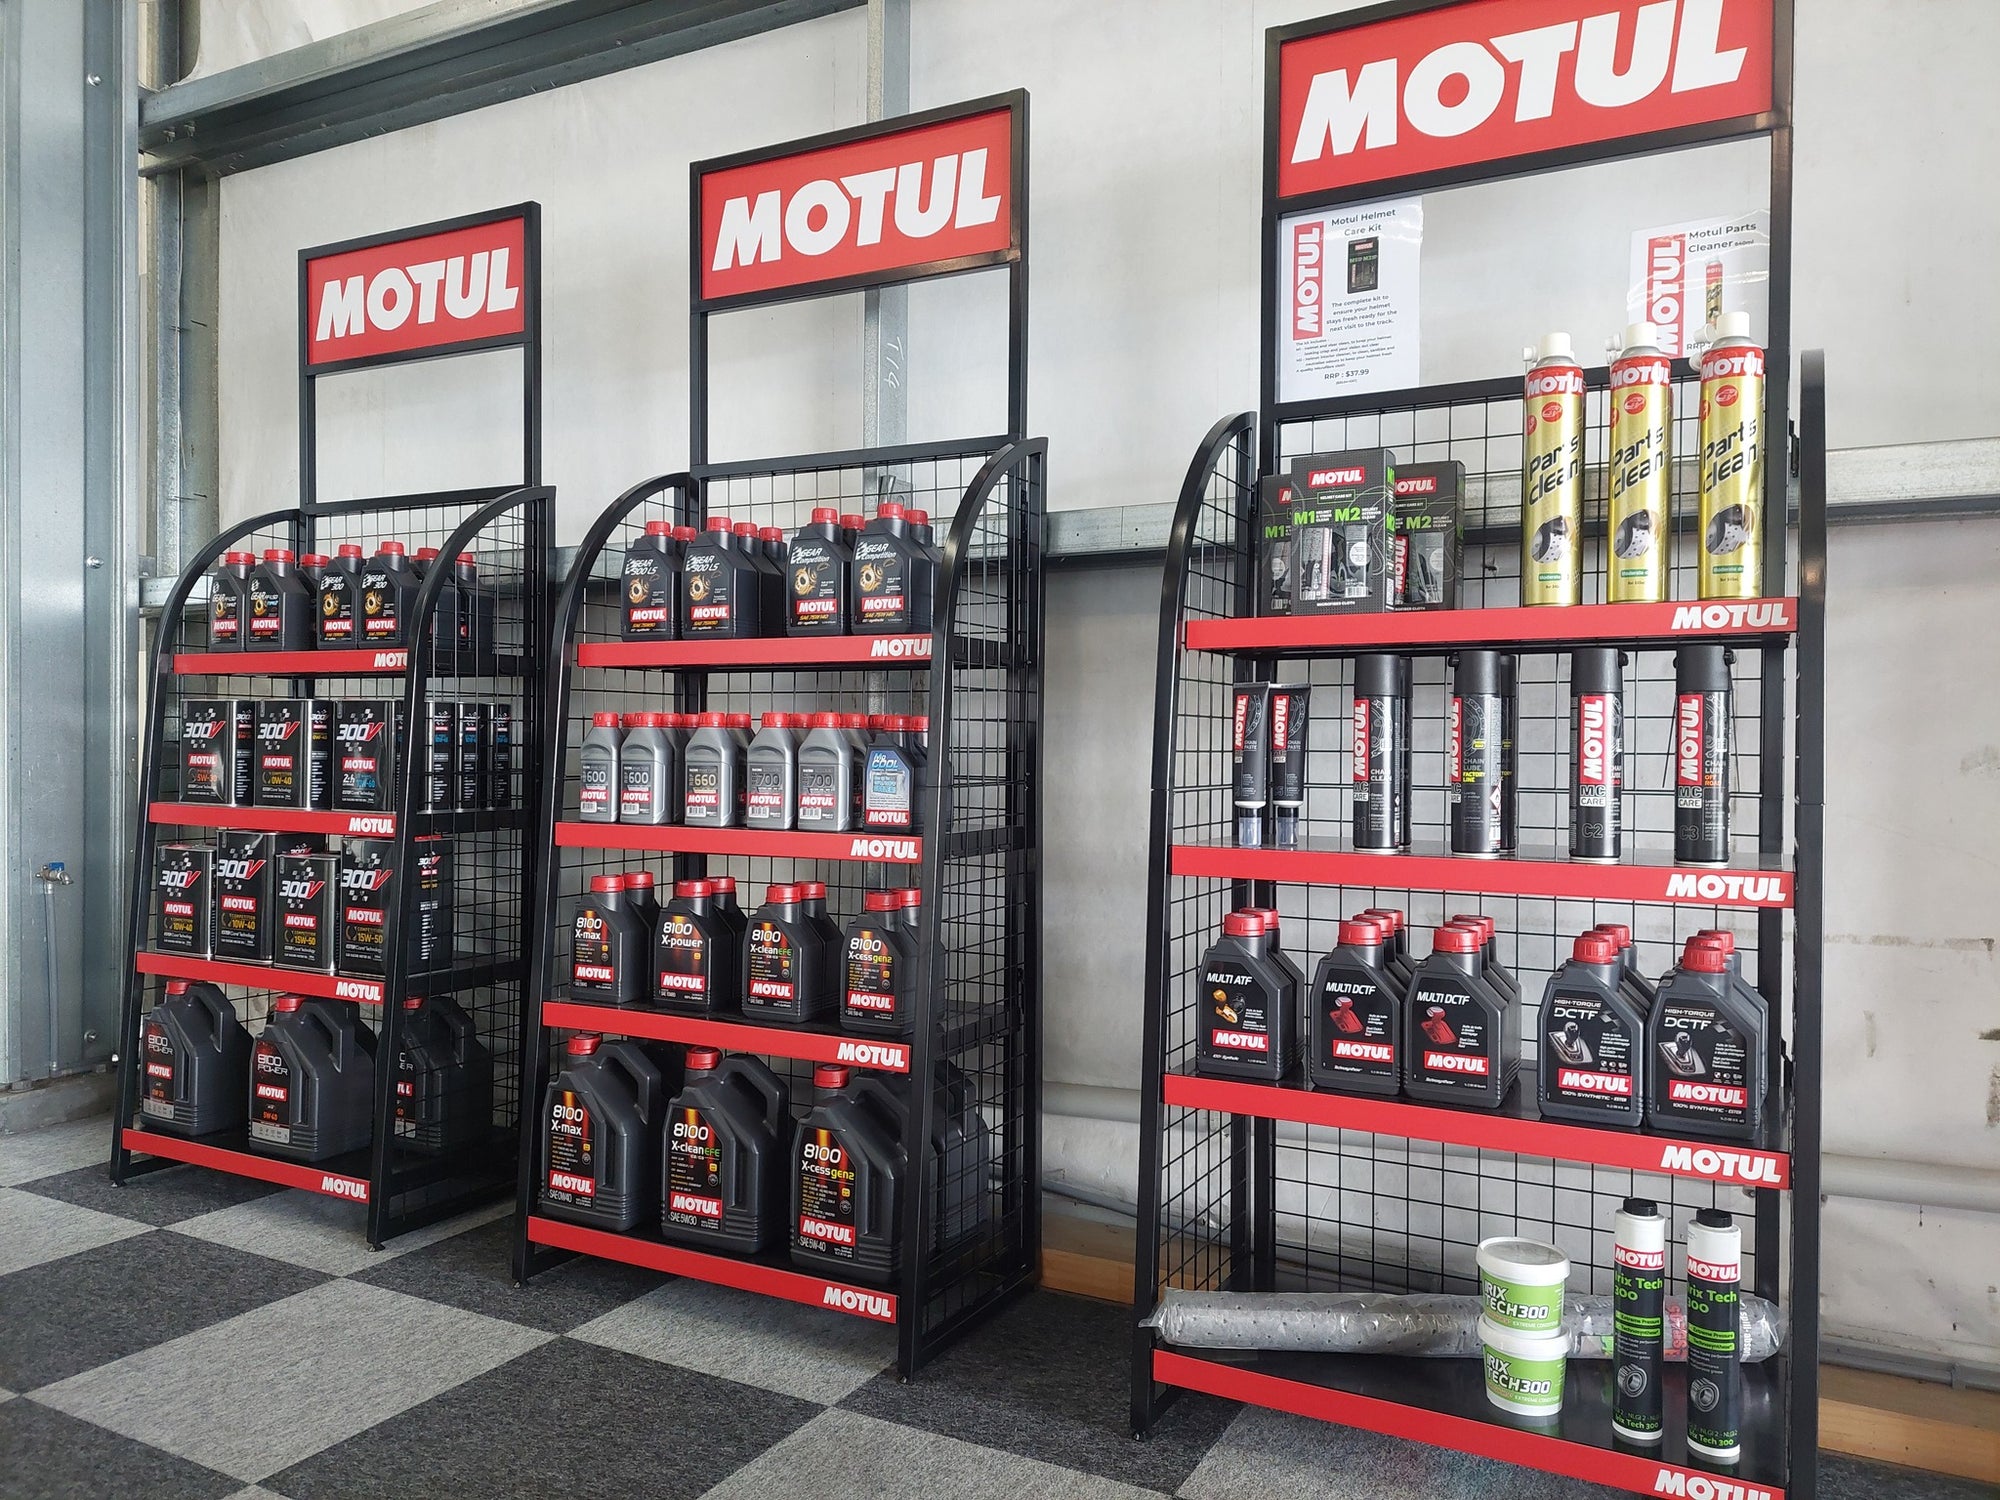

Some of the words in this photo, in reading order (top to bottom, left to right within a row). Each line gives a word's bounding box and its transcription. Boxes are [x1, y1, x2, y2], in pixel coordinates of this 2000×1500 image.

[1291, 0, 1748, 164] MOTUL
[711, 147, 1002, 271] MOTUL
[1331, 215, 1359, 226] Motul
[1361, 209, 1396, 221] Helmet
[1344, 227, 1366, 237] Care
[1368, 224, 1382, 233] Kit
[1689, 227, 1722, 240] Motul
[1726, 223, 1757, 234] Parts
[1688, 240, 1733, 253] Cleaner
[1297, 227, 1320, 333] MOTUL
[315, 247, 519, 342] MOTUL
[1651, 240, 1681, 355] MOTUL
[1333, 308, 1353, 316] ensure
[1354, 306, 1368, 314] your
[1369, 302, 1391, 310] helmet
[1344, 298, 1371, 307] complete
[1326, 318, 1341, 326] stays
[1359, 312, 1376, 321] ready
[1325, 372, 1340, 380] RRP
[1345, 368, 1370, 378] $37.99
[1611, 362, 1670, 388] MOTUL
[1701, 355, 1763, 381] MOTUL
[1527, 375, 1584, 396] MOTUL
[1311, 469, 1362, 486] MOTUL
[1294, 510, 1315, 525] M1
[1334, 507, 1361, 522] M2
[1406, 516, 1432, 529] M2
[1265, 525, 1285, 538] M1
[801, 547, 823, 557] GEAR
[866, 543, 889, 552] GEAR
[796, 556, 830, 565] Competition
[861, 552, 897, 561] Competition
[799, 601, 835, 613] MOTUL
[864, 598, 902, 610] MOTUL
[632, 609, 665, 620] MOTUL
[693, 607, 728, 618] MOTUL
[1671, 604, 1788, 630] MOTUL
[214, 621, 236, 630] MOTUL
[252, 620, 278, 629] MOTUL
[325, 621, 351, 631] MOTUL
[367, 620, 394, 630] MOTUL
[1235, 698, 1246, 747] MOTUL
[1274, 698, 1287, 747] MOTUL
[183, 721, 226, 739] 300V
[257, 721, 300, 740] 300V
[336, 722, 385, 741] 300V
[1354, 703, 1366, 777] MOTUL
[1451, 702, 1459, 777] MOTUL
[1584, 700, 1605, 780] MOTUL
[1681, 698, 1699, 782] MOTUL
[189, 755, 217, 764] MOTUL
[264, 757, 291, 767] MOTUL
[344, 759, 374, 770] MOTUL
[872, 760, 899, 769] COOL
[271, 776, 292, 785] 0W-40
[587, 771, 606, 783] 600
[629, 772, 649, 784] 600
[694, 774, 716, 786] 660
[759, 773, 781, 786] 700
[810, 774, 834, 787] 700
[581, 791, 607, 800] MOTUL
[623, 792, 649, 802] MOTUL
[1580, 785, 1606, 797] MC
[1678, 786, 1702, 798] MC
[687, 794, 717, 804] MOTUL
[750, 795, 781, 805] MOTUL
[801, 796, 834, 806] MOTUL
[1581, 797, 1604, 806] CARE
[1679, 799, 1700, 807] CARE
[868, 811, 908, 824] MOTUL
[349, 817, 394, 833] MOTUL
[1582, 823, 1604, 839] C2
[1679, 825, 1700, 841] C3
[850, 839, 918, 859] MOTUL
[217, 858, 267, 880] 300V
[159, 870, 201, 888] 300V
[340, 868, 393, 891] 300V
[279, 880, 325, 900] 300V
[1666, 874, 1786, 901] MOTUL
[165, 904, 192, 914] MOTUL
[223, 897, 254, 910] MOTUL
[286, 915, 315, 927] MOTUL
[347, 909, 382, 923] MOTUL
[576, 917, 602, 929] 8100
[231, 919, 256, 930] 10W-40
[663, 921, 693, 935] 8100
[294, 935, 316, 946] 15W-50
[357, 932, 383, 944] 15W-50
[575, 928, 601, 940] X-max
[661, 934, 703, 948] X-power
[751, 929, 781, 943] 8100
[850, 938, 882, 952] 8100
[577, 967, 611, 980] MOTUL
[1206, 972, 1234, 984] MULTI
[1233, 975, 1253, 986] ATF
[663, 975, 702, 989] MOTUL
[1325, 982, 1352, 994] MULTI
[1351, 984, 1376, 995] DCTF
[336, 981, 381, 1000] MOTUL
[752, 982, 791, 997] MOTUL
[850, 993, 892, 1009] MOTUL
[1416, 991, 1443, 1004] MULTI
[1444, 994, 1470, 1006] DCTF
[1554, 999, 1601, 1008] HIGH-TORQUE
[1554, 1007, 1598, 1021] DCTF
[1664, 1008, 1715, 1017] HIGH-TORQUE
[1664, 1017, 1711, 1030] DCTF
[1215, 1032, 1266, 1049] MOTUL
[148, 1044, 173, 1055] POWER
[837, 1042, 904, 1068] MOTUL
[1336, 1042, 1391, 1060] MOTUL
[257, 1053, 282, 1067] 8100
[1427, 1054, 1486, 1072] MOTUL
[149, 1064, 171, 1077] MOTUL
[257, 1063, 288, 1076] POWER
[1562, 1070, 1629, 1093] MOTUL
[258, 1086, 285, 1099] MOTUL
[1577, 1092, 1610, 1101] SYNTHETIC
[1673, 1083, 1744, 1104] MOTUL
[553, 1104, 584, 1122] 8100
[1689, 1104, 1725, 1113] SYNTHETIC
[551, 1119, 582, 1136] X-max
[673, 1123, 709, 1141] 8100
[804, 1143, 841, 1164] 8100
[1660, 1145, 1782, 1183] MOTUL
[321, 1176, 367, 1200] MOTUL
[552, 1173, 592, 1193] MOTUL
[673, 1195, 719, 1215] MOTUL
[803, 1220, 851, 1243] MOTUL
[1615, 1247, 1663, 1268] MOTUL
[1688, 1259, 1737, 1280] MOTUL
[1635, 1277, 1663, 1290] Tech
[823, 1286, 891, 1318] MOTUL
[1706, 1289, 1737, 1303] Tech
[1485, 1294, 1549, 1319] TECH300
[1487, 1366, 1551, 1394] TECH300
[1626, 1419, 1644, 1429] Tech
[1646, 1422, 1659, 1430] 300
[1699, 1434, 1717, 1445] Tech
